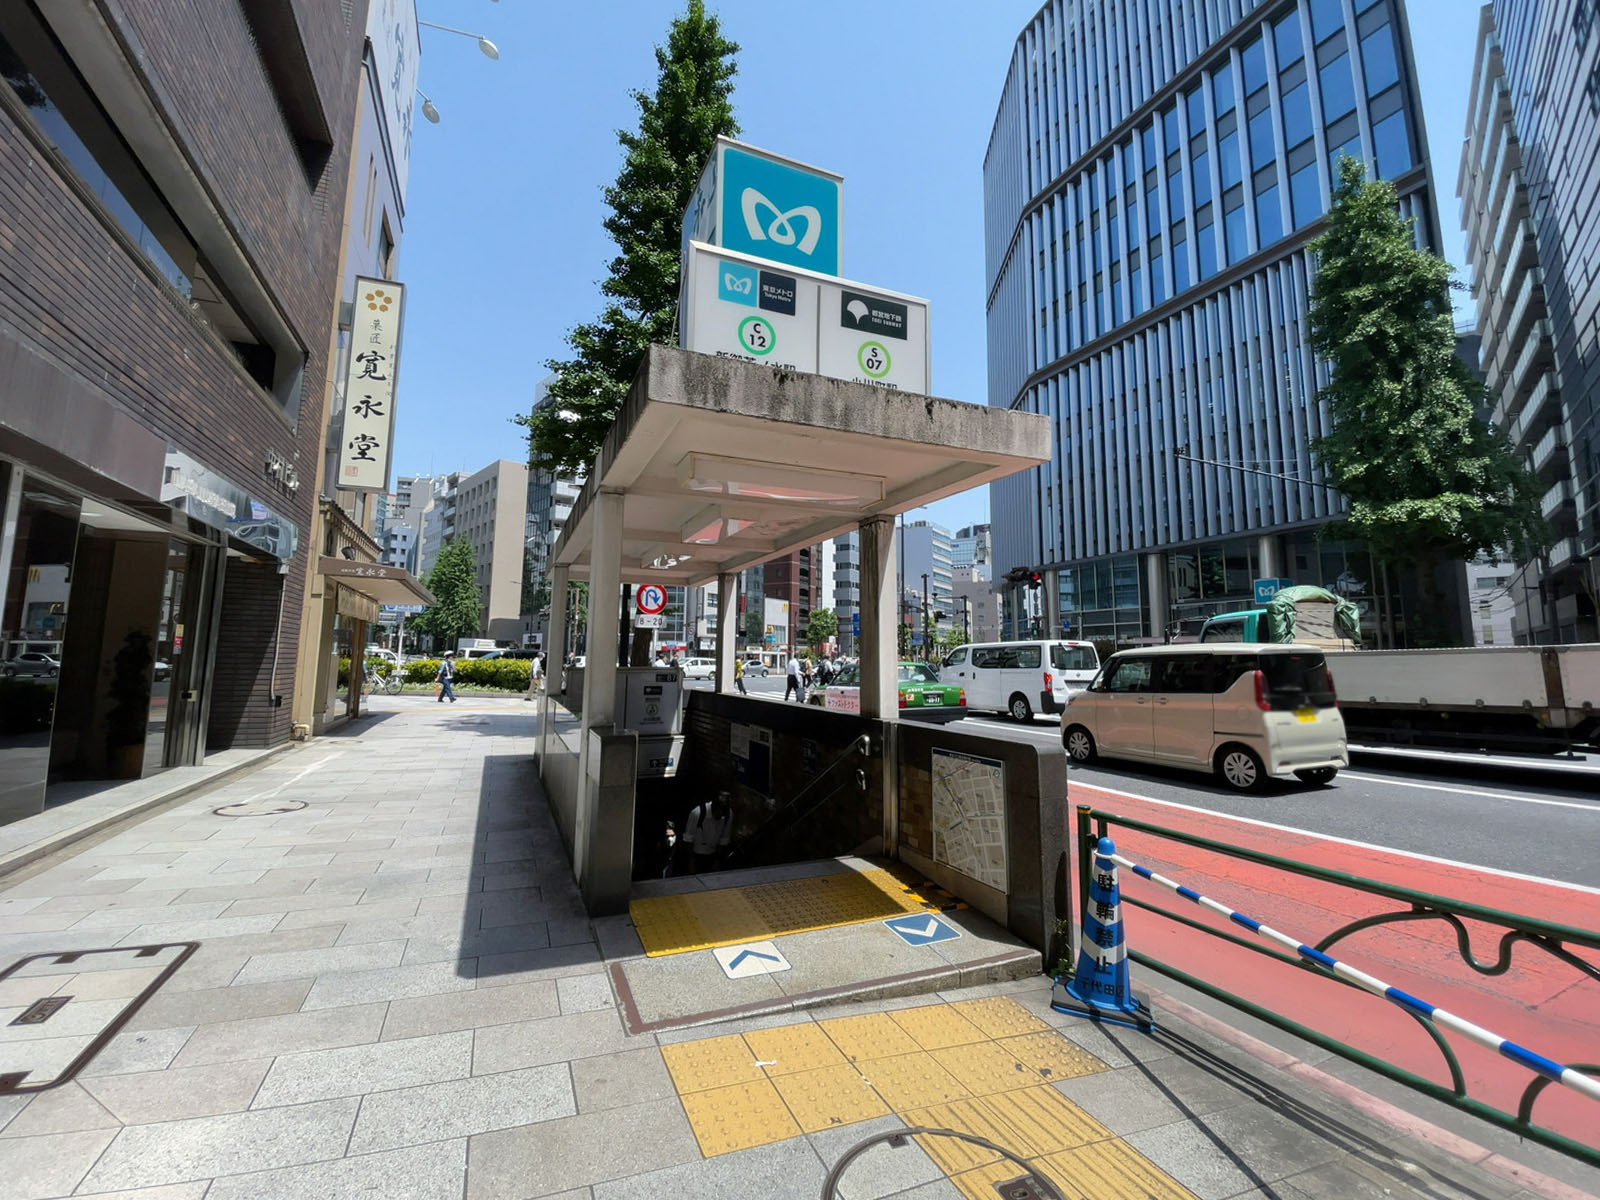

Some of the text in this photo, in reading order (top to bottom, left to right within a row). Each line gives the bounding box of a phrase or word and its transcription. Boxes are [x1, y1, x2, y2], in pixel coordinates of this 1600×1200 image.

[752, 322, 762, 335] C
[749, 333, 766, 348] 12
[871, 347, 878, 358] S
[866, 358, 882, 371] 07
[348, 350, 388, 462] 寛永堂
[1094, 873, 1116, 976] 駐輪禁止
[1079, 976, 1125, 999] 千代田区
